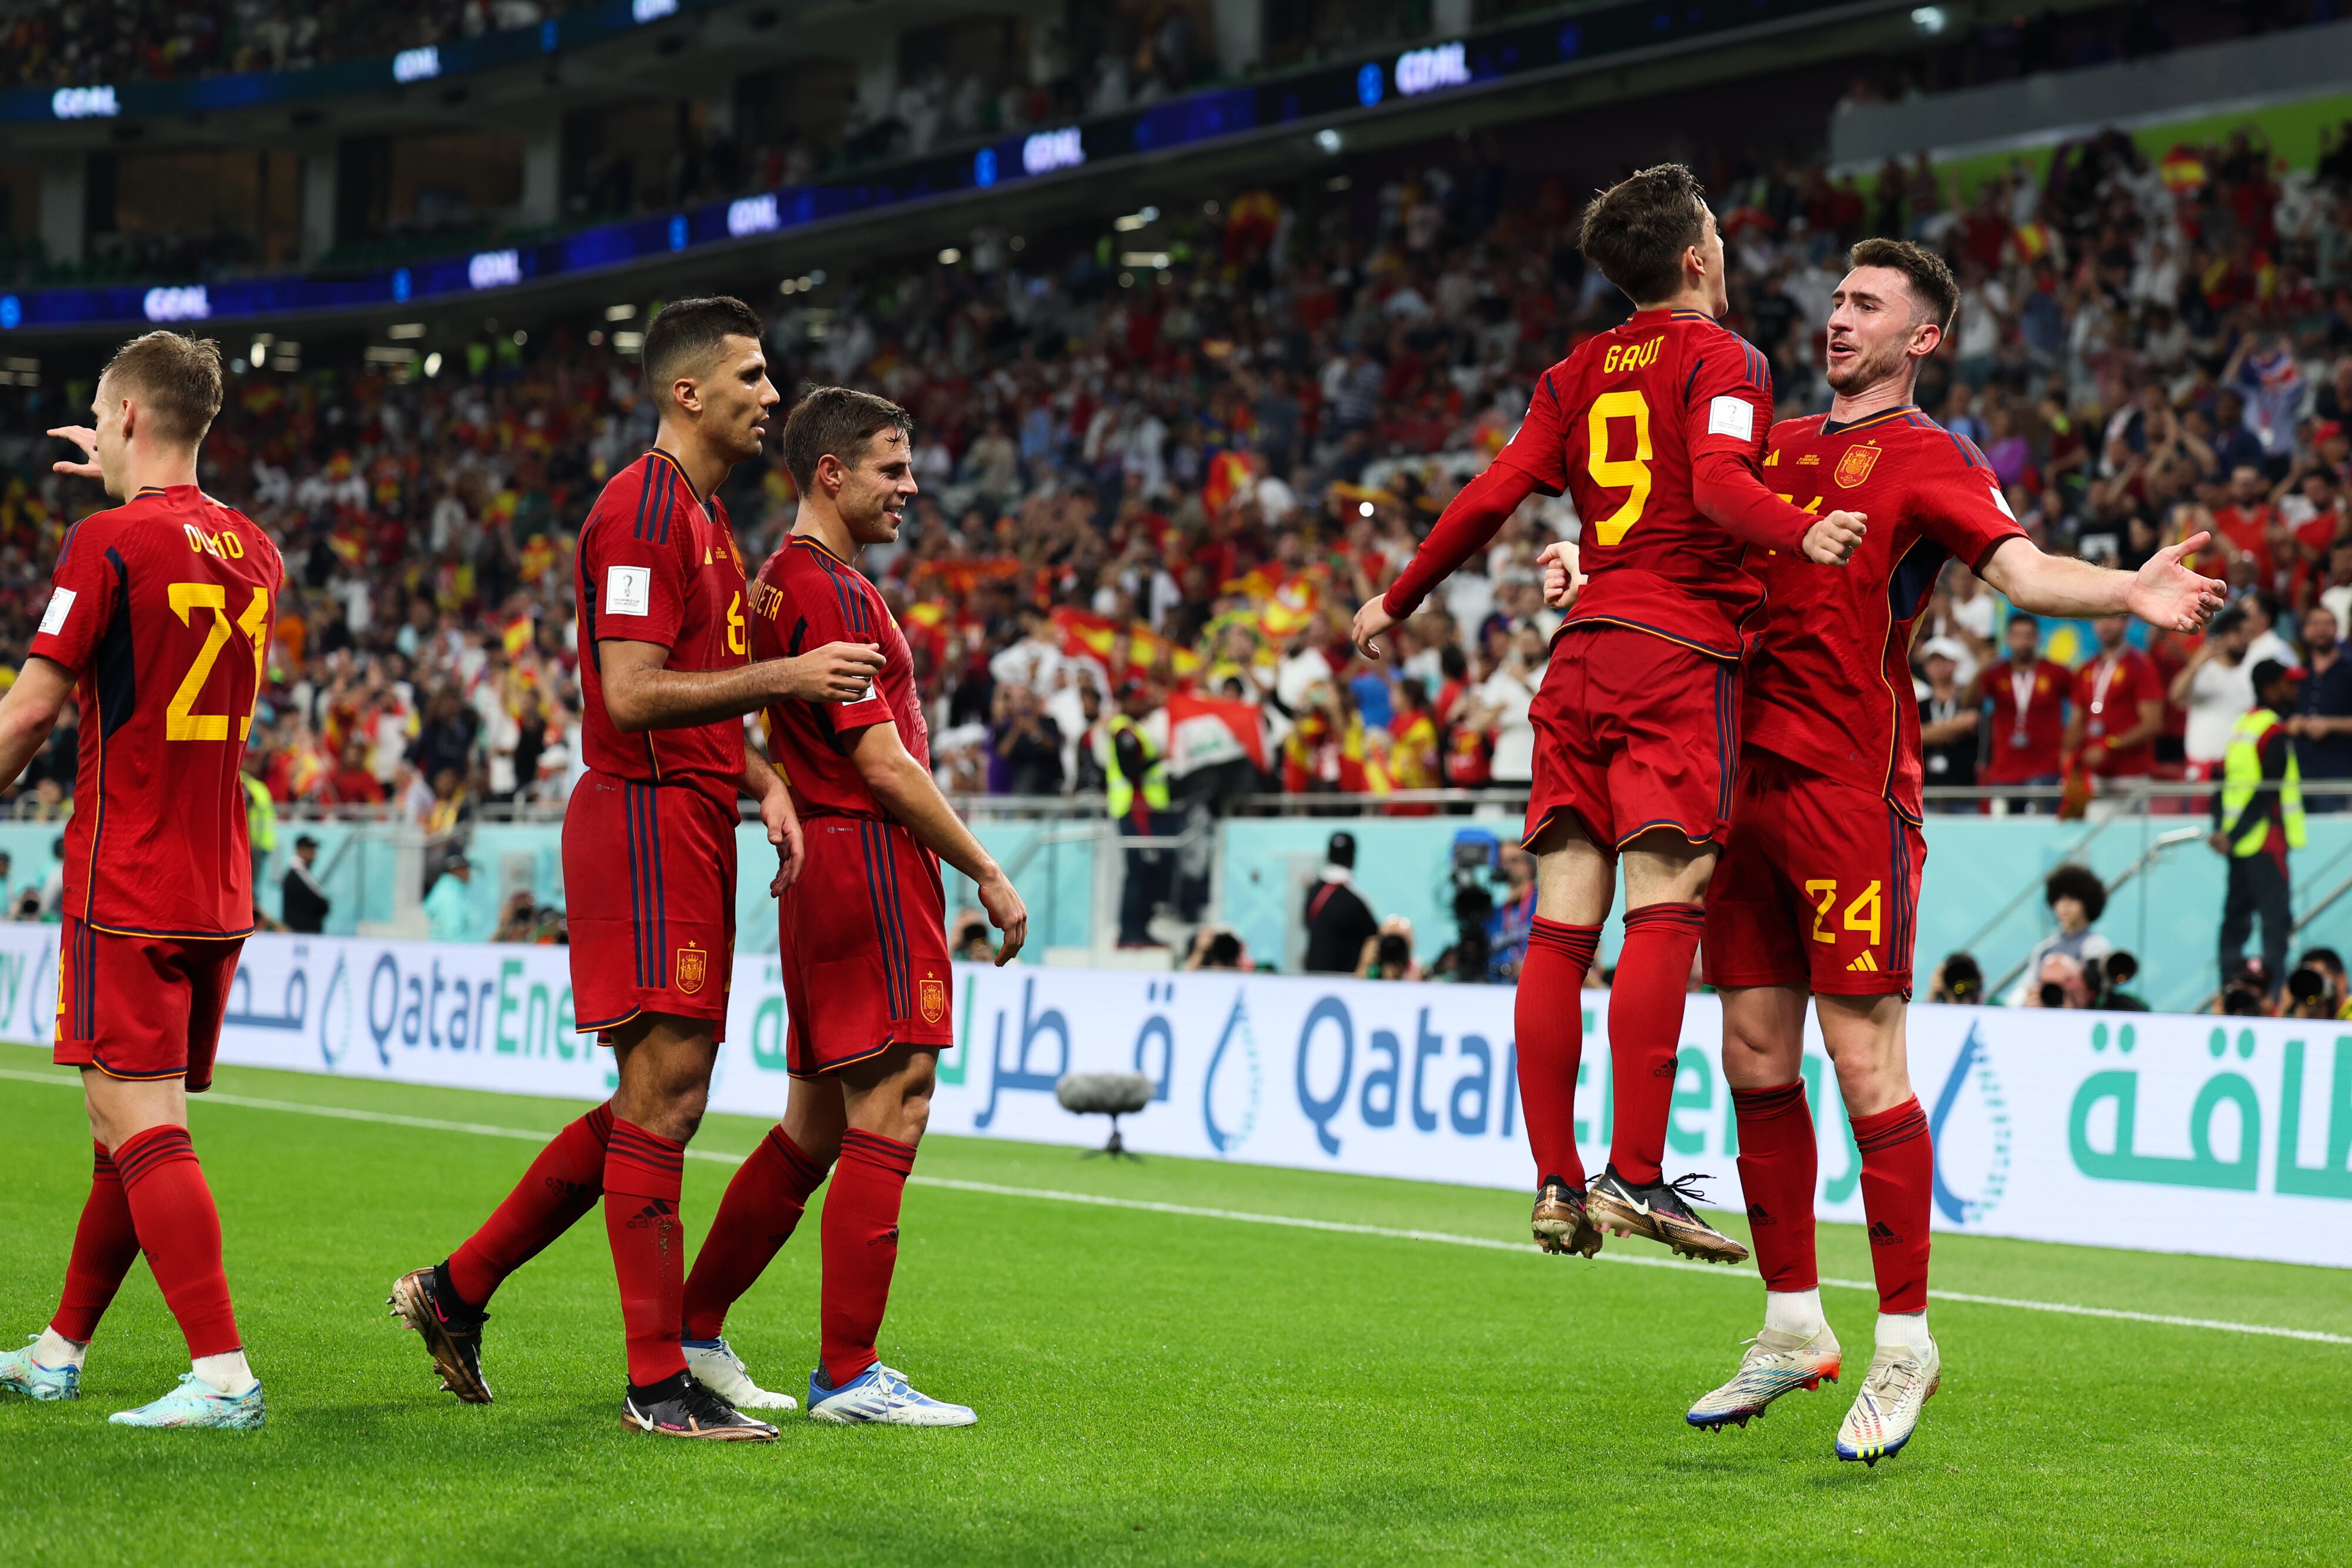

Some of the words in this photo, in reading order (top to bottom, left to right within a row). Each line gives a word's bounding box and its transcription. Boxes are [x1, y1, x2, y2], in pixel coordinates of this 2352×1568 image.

[1603, 335, 1665, 374] GAVI
[1588, 390, 1653, 546] 9
[166, 582, 269, 741] 21
[1805, 879, 1881, 945] 24
